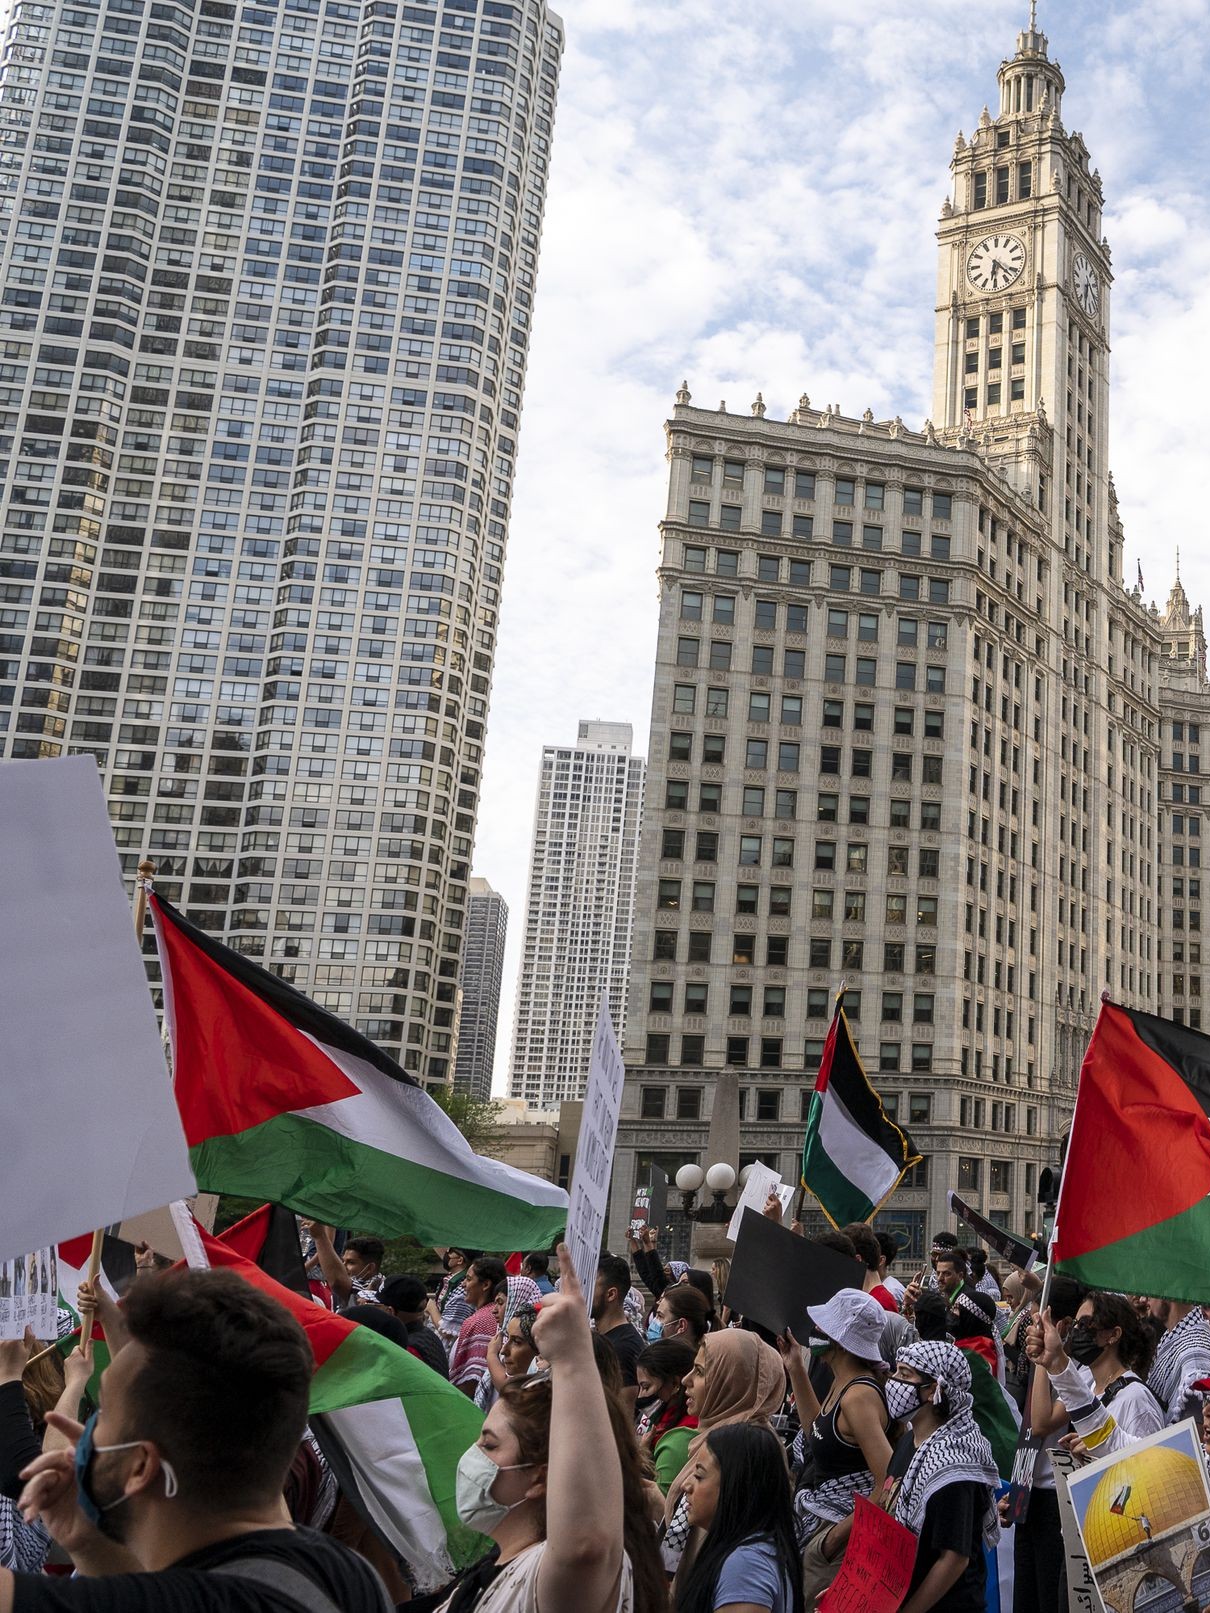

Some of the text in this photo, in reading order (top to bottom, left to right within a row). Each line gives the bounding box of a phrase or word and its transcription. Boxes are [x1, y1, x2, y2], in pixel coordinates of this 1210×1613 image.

[1198, 1521, 1210, 1541] 6
[852, 1532, 862, 1553] IS
[866, 1545, 881, 1568] NOT
[856, 1564, 871, 1585] WANT
